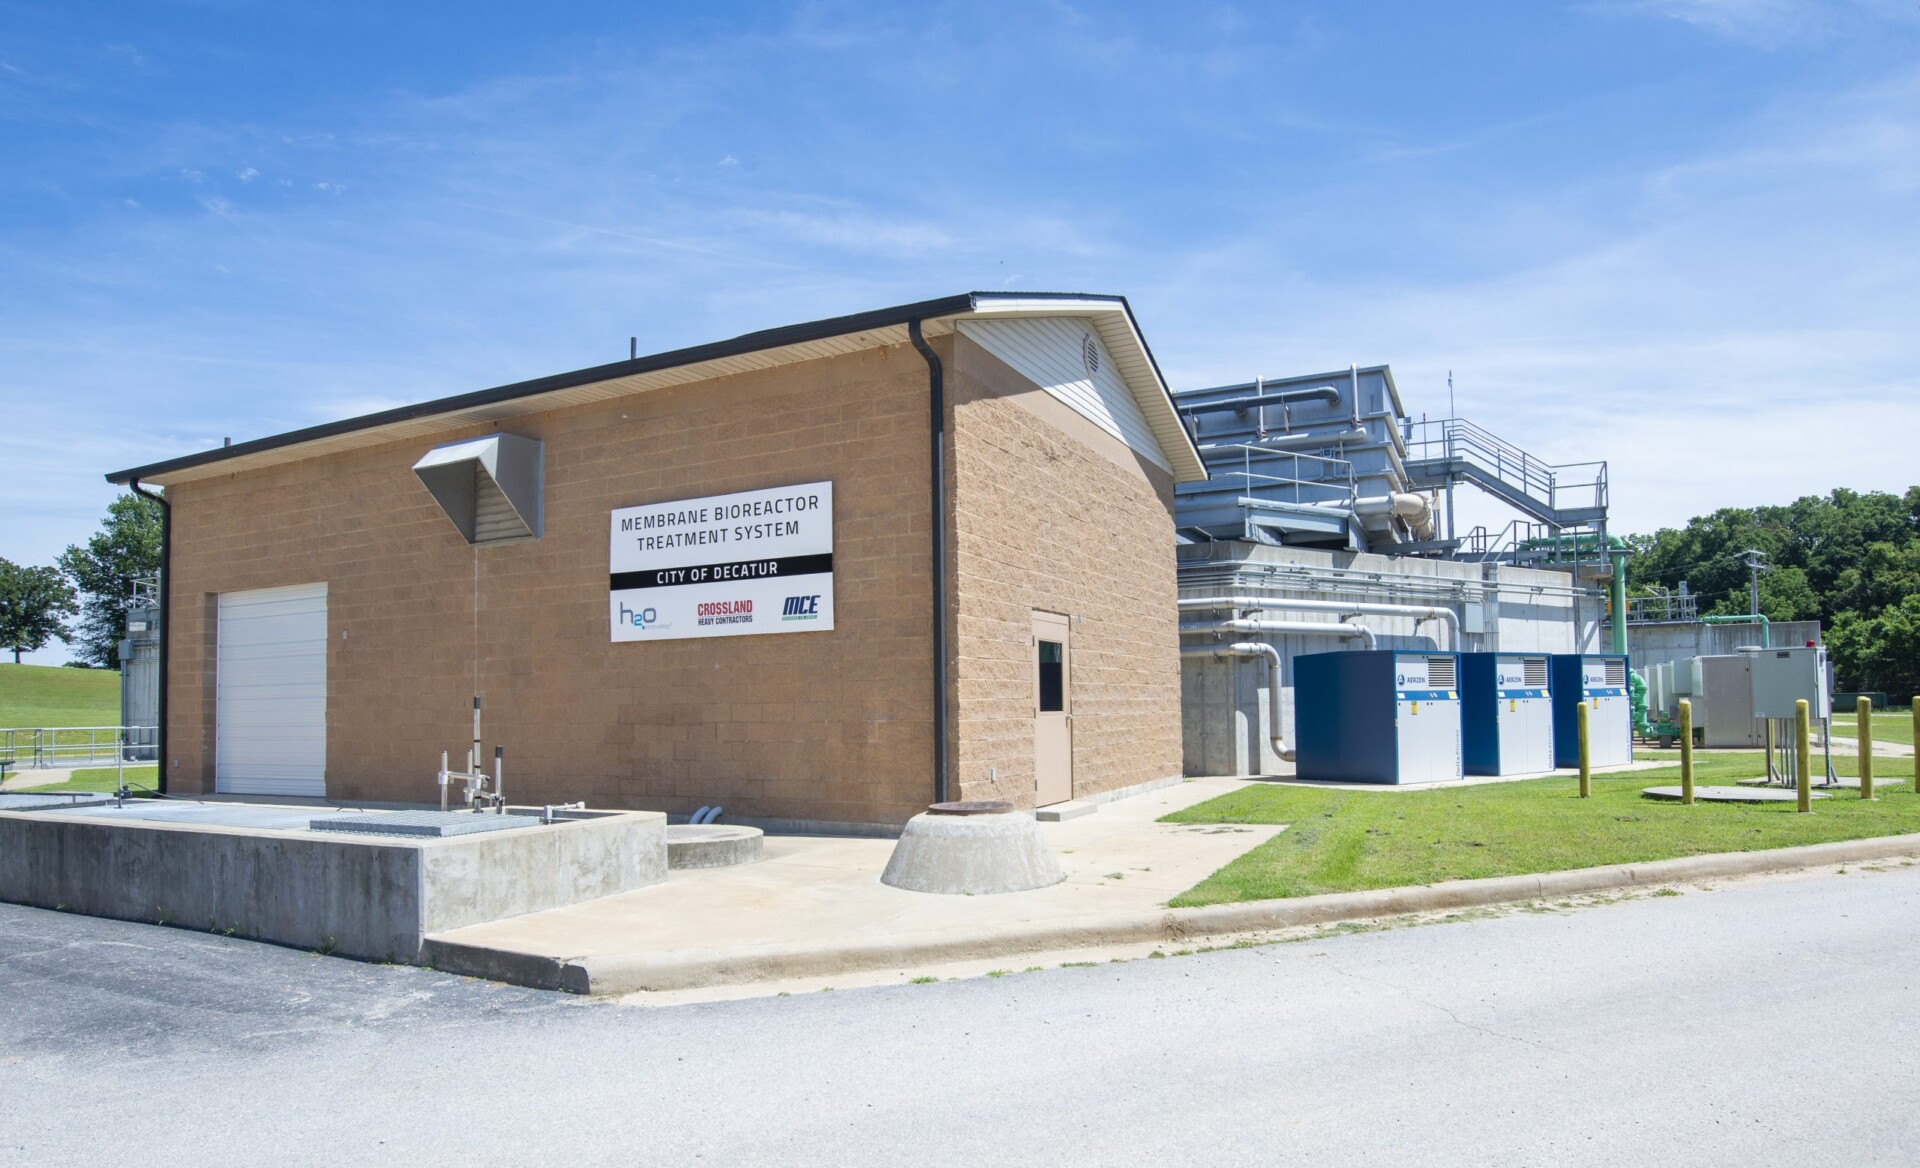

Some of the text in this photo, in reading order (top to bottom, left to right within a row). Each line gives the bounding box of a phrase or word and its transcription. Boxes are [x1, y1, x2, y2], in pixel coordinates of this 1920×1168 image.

[621, 495, 819, 532] MEMBRANE BIOREACTOR
[637, 520, 799, 551] TREATMENT SYSTEM
[656, 561, 778, 584] CITY OF DECATUR
[697, 599, 753, 616] CROSSLAND
[782, 594, 821, 615] MCE
[698, 615, 753, 626] HEAVY CONTRACTORS
[1406, 676, 1426, 684] AERZEN
